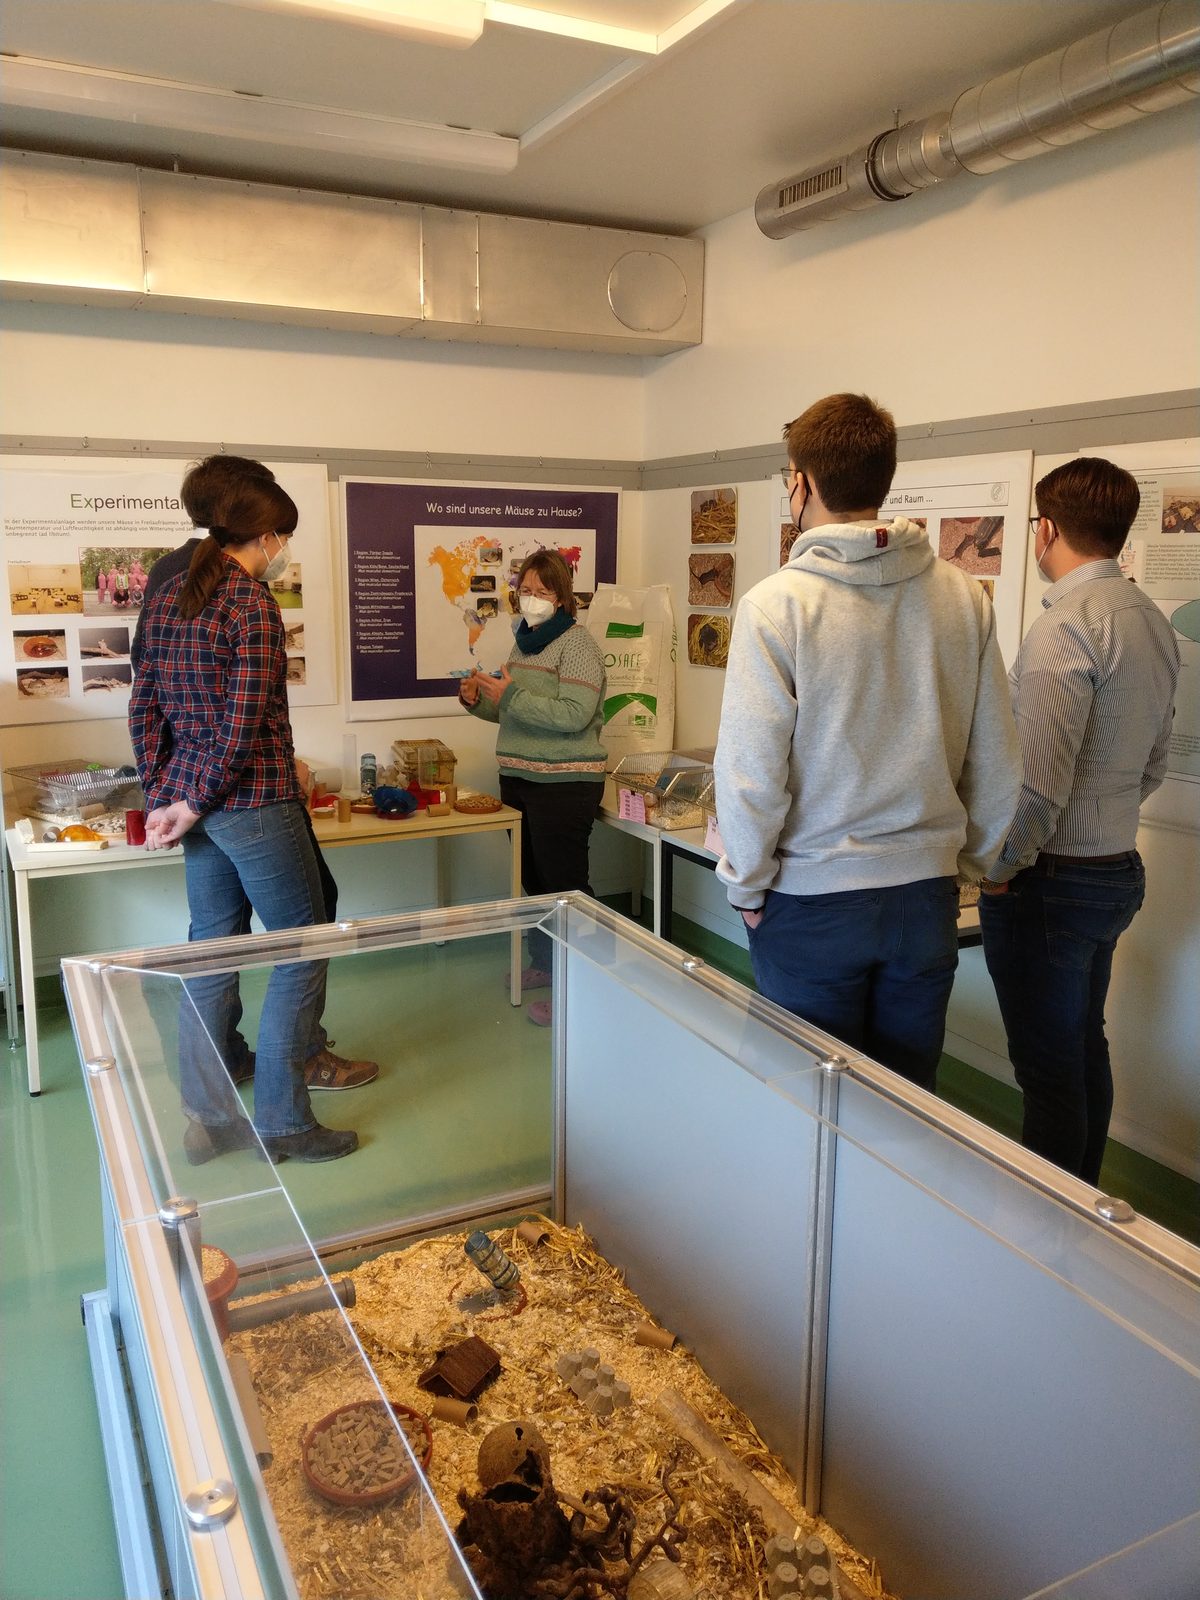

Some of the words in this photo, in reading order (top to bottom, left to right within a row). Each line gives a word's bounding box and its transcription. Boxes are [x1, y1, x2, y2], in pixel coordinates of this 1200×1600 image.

[889, 495, 903, 504] und
[904, 494, 924, 504] Raum
[426, 502, 443, 513] Wo
[445, 503, 466, 514] sind
[469, 505, 501, 515] unsere
[504, 505, 535, 516] Mäuse
[537, 507, 548, 517] zu
[551, 506, 583, 517] Hause?
